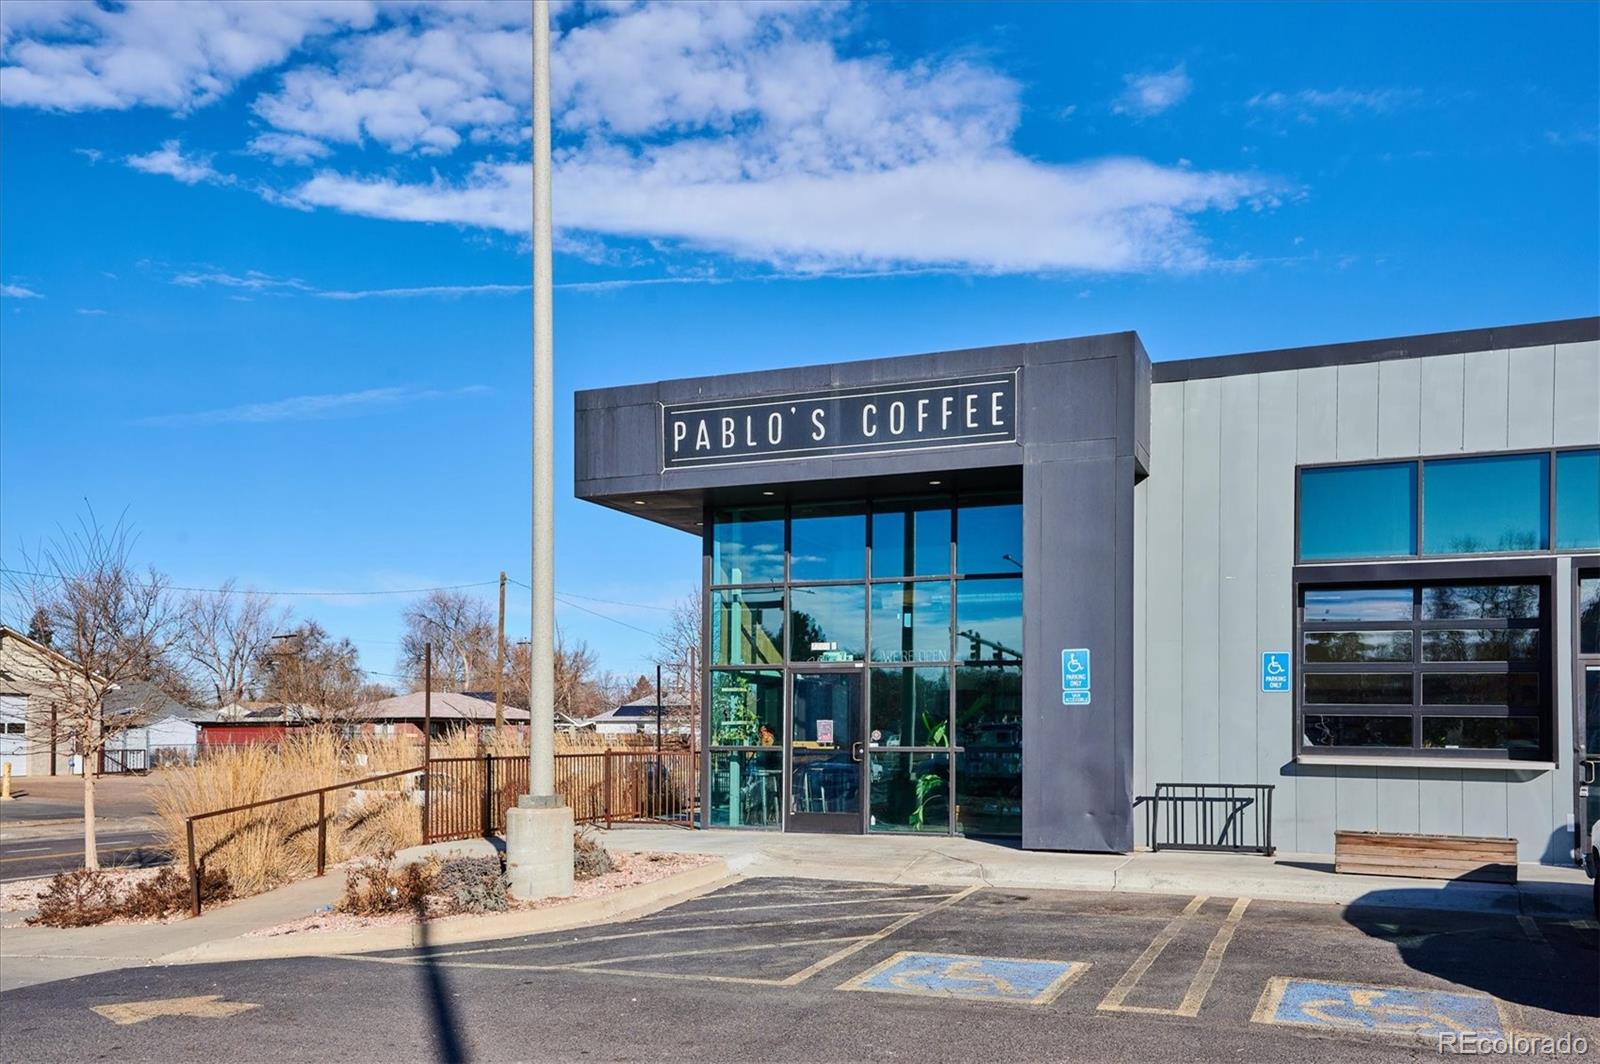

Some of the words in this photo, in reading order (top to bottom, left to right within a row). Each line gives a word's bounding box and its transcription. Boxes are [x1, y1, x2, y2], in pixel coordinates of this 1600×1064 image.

[673, 406, 827, 453] PABLO'S
[862, 391, 1005, 438] COFFEE
[1265, 675, 1288, 683] PARKING
